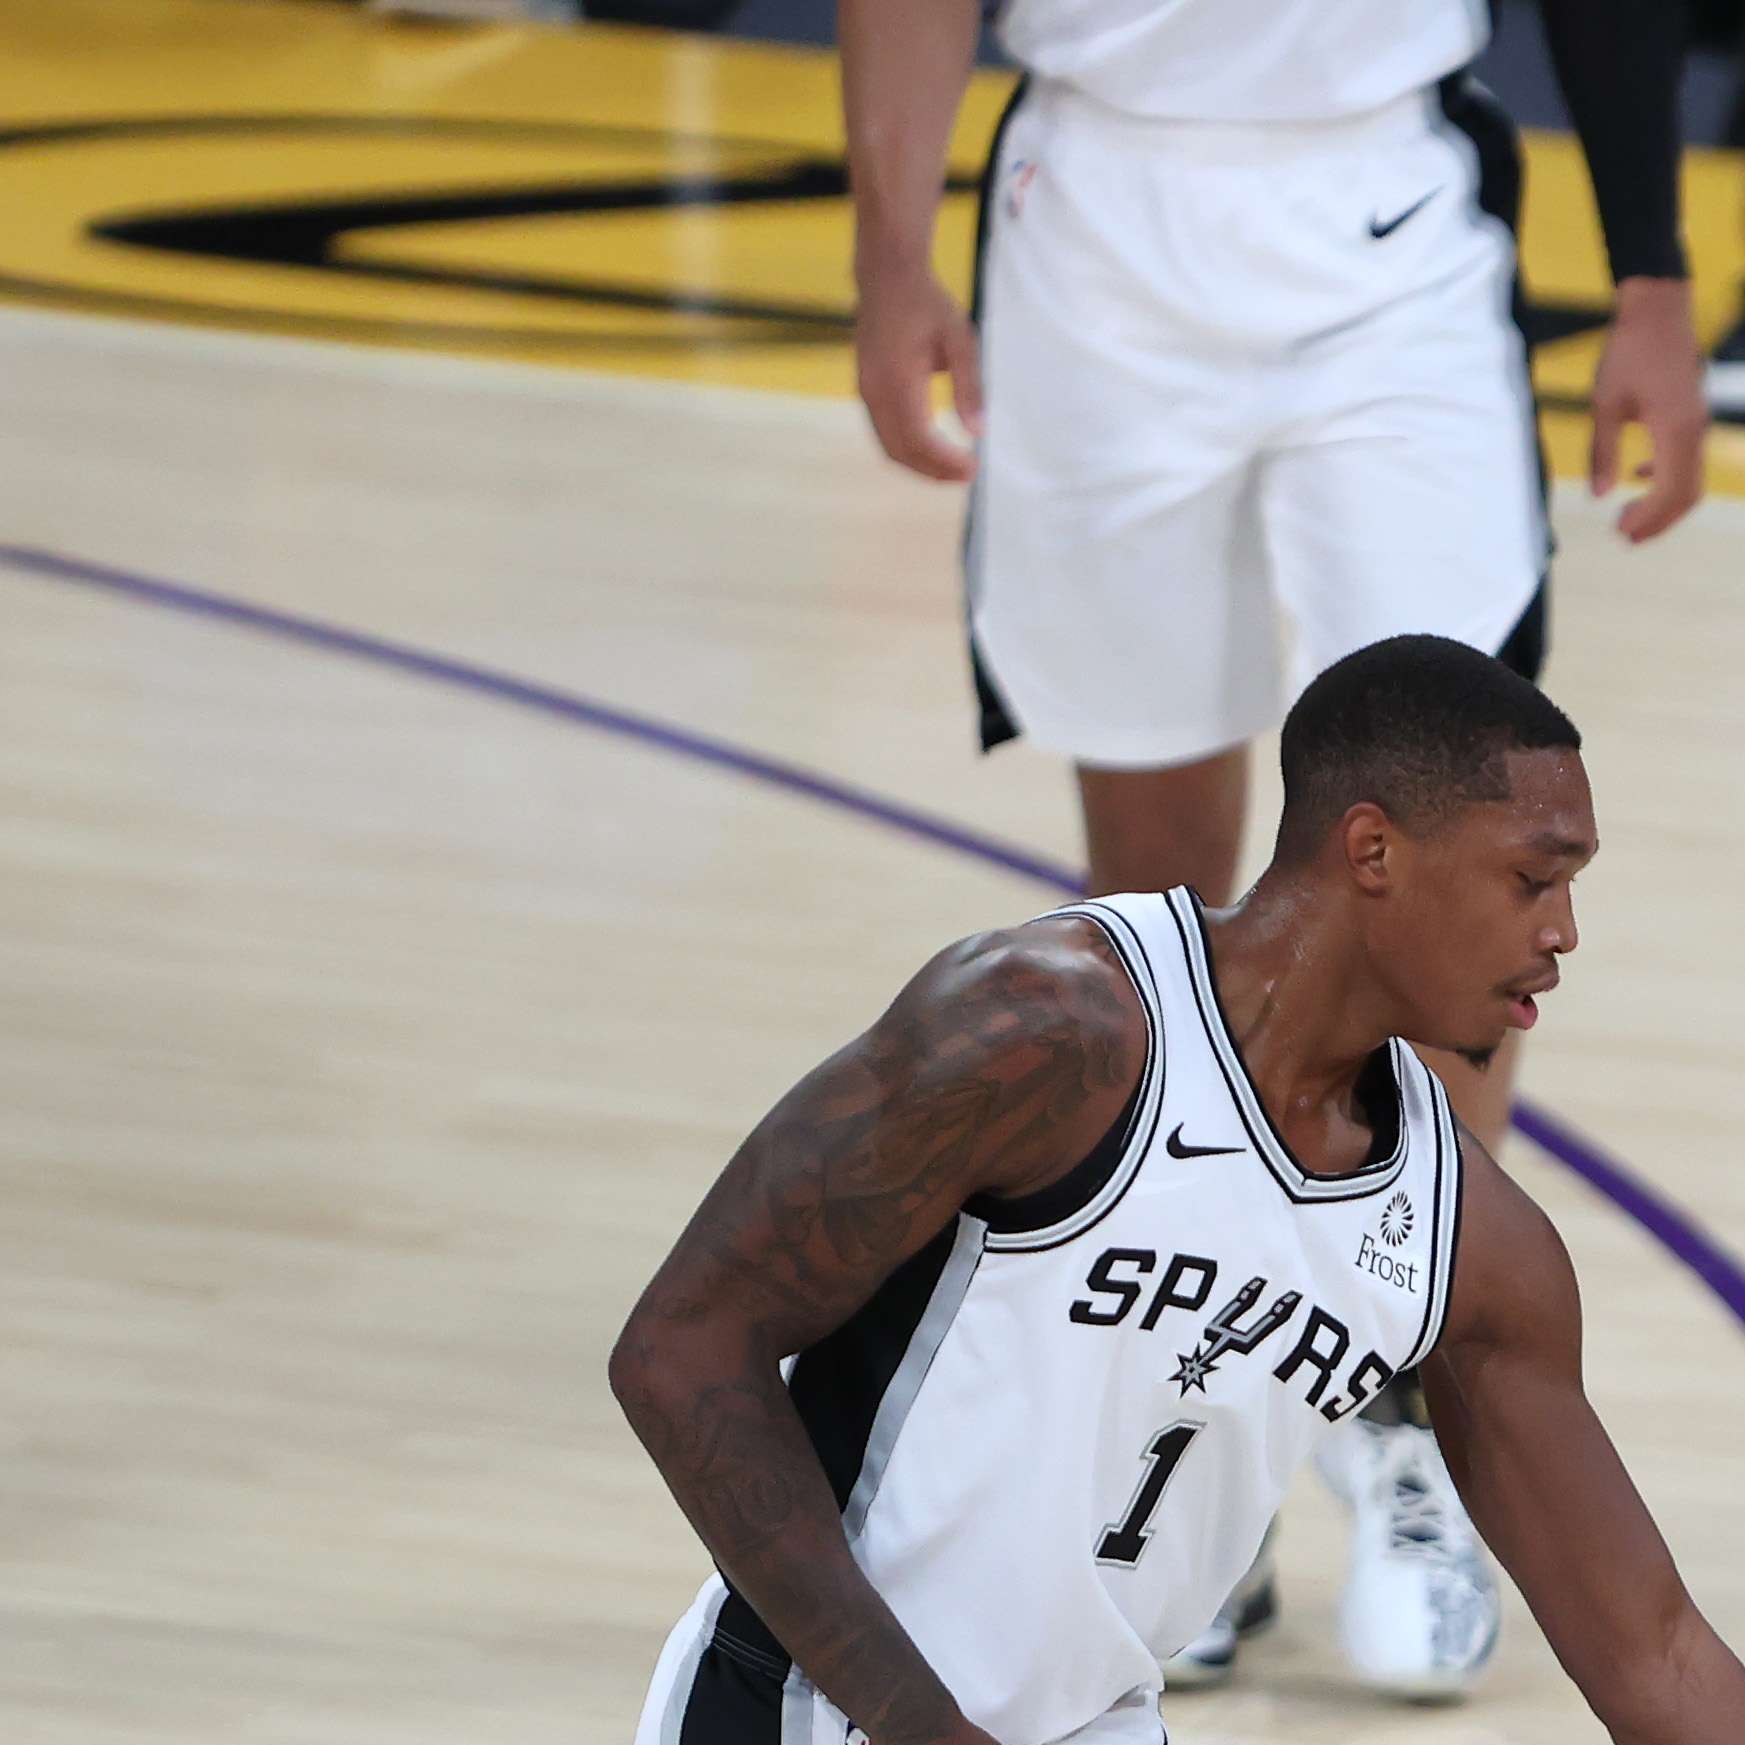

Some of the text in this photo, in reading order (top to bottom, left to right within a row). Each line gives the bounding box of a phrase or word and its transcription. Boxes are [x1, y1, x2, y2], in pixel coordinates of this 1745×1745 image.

[1069, 1247, 1394, 1424] SPURS
[1354, 1232, 1419, 1295] Frost
[1093, 1418, 1207, 1569] 1
